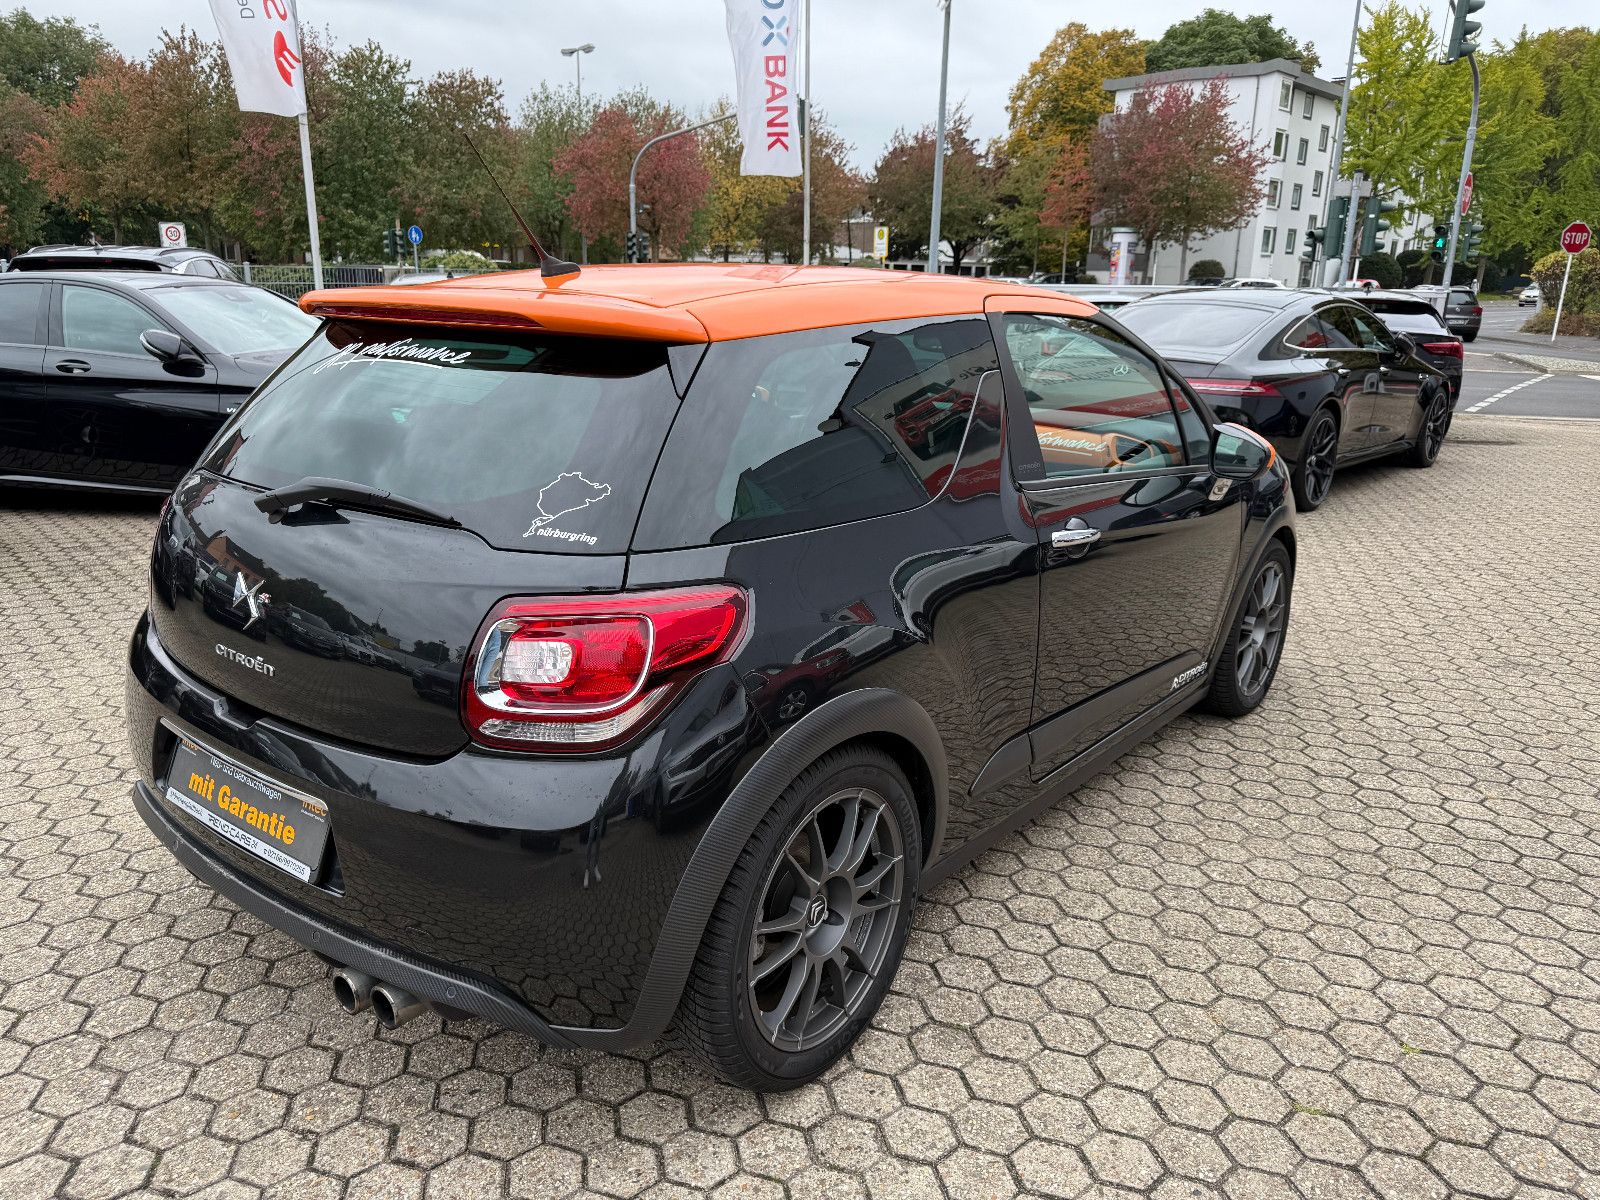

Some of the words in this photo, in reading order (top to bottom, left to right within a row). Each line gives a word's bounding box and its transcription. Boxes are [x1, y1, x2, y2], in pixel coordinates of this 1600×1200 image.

[763, 55, 789, 153] BANK
[168, 229, 178, 238] 30
[1564, 231, 1588, 245] STOP
[360, 338, 472, 365] performance
[536, 527, 598, 546] nürburgring
[233, 770, 282, 801] Gebrauchtwagen
[188, 772, 215, 802] mit
[217, 784, 296, 845] Garantie
